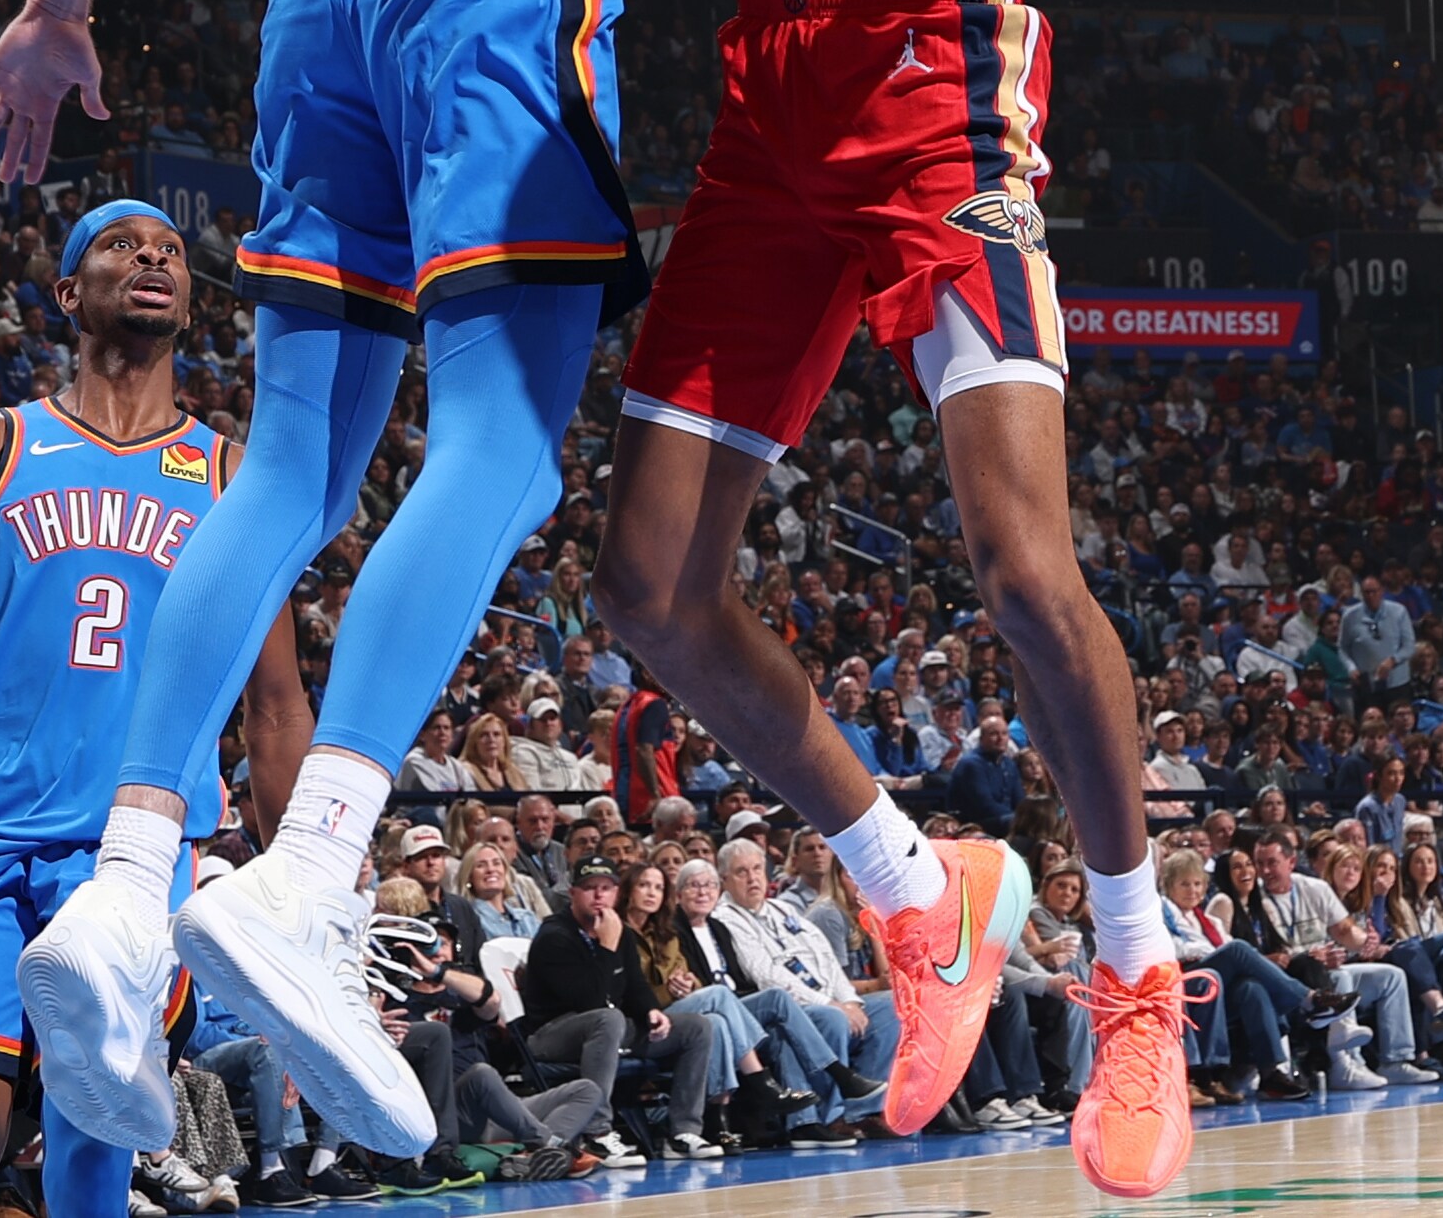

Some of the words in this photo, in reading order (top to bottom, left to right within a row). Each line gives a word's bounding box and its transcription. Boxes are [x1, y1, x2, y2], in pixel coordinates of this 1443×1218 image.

[157, 185, 210, 232] 108
[1347, 257, 1408, 296] 109
[1063, 307, 1106, 333] OR
[1112, 309, 1280, 336] GREATNESS!
[3, 489, 197, 570] THUNDE
[68, 574, 130, 671] 2
